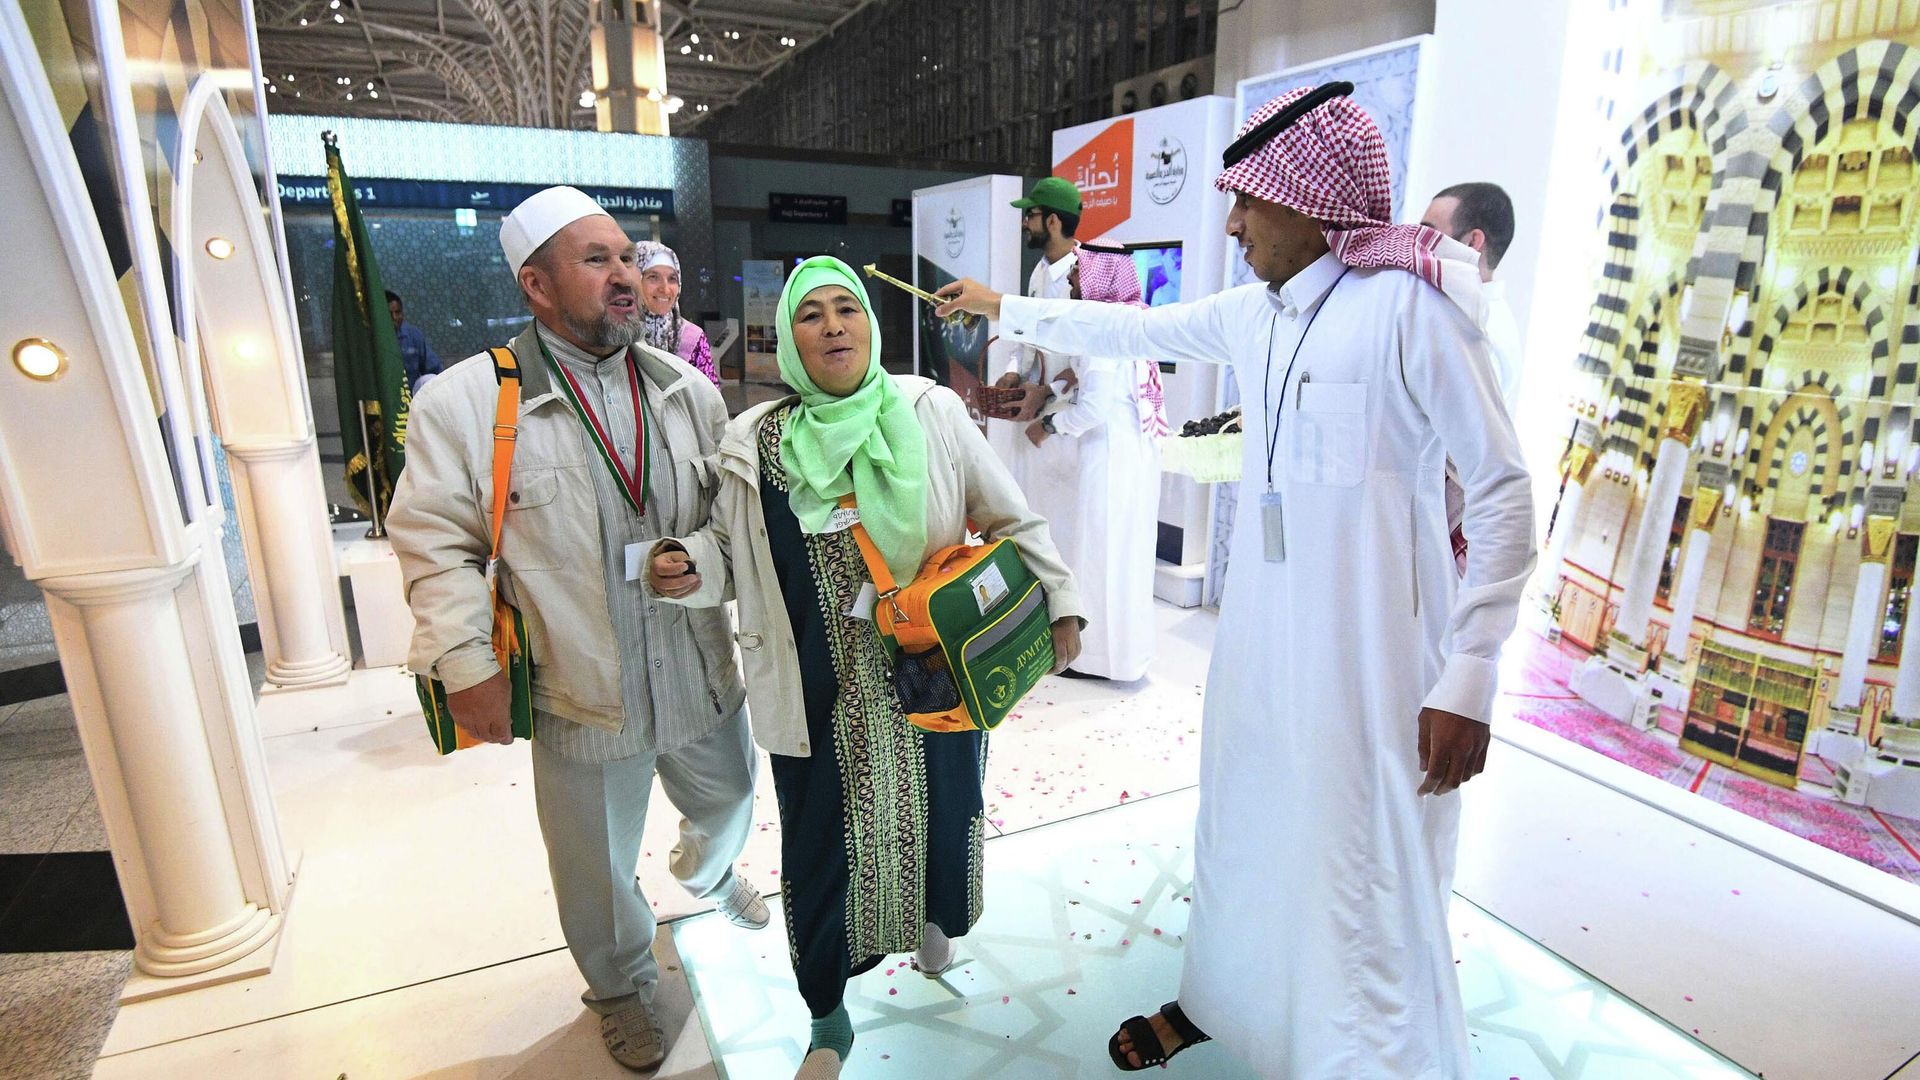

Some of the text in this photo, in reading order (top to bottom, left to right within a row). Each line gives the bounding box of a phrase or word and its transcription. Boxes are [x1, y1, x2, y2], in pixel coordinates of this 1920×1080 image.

[277, 183, 377, 202] Departs 1
[593, 194, 663, 211] مغادرة الحجا
